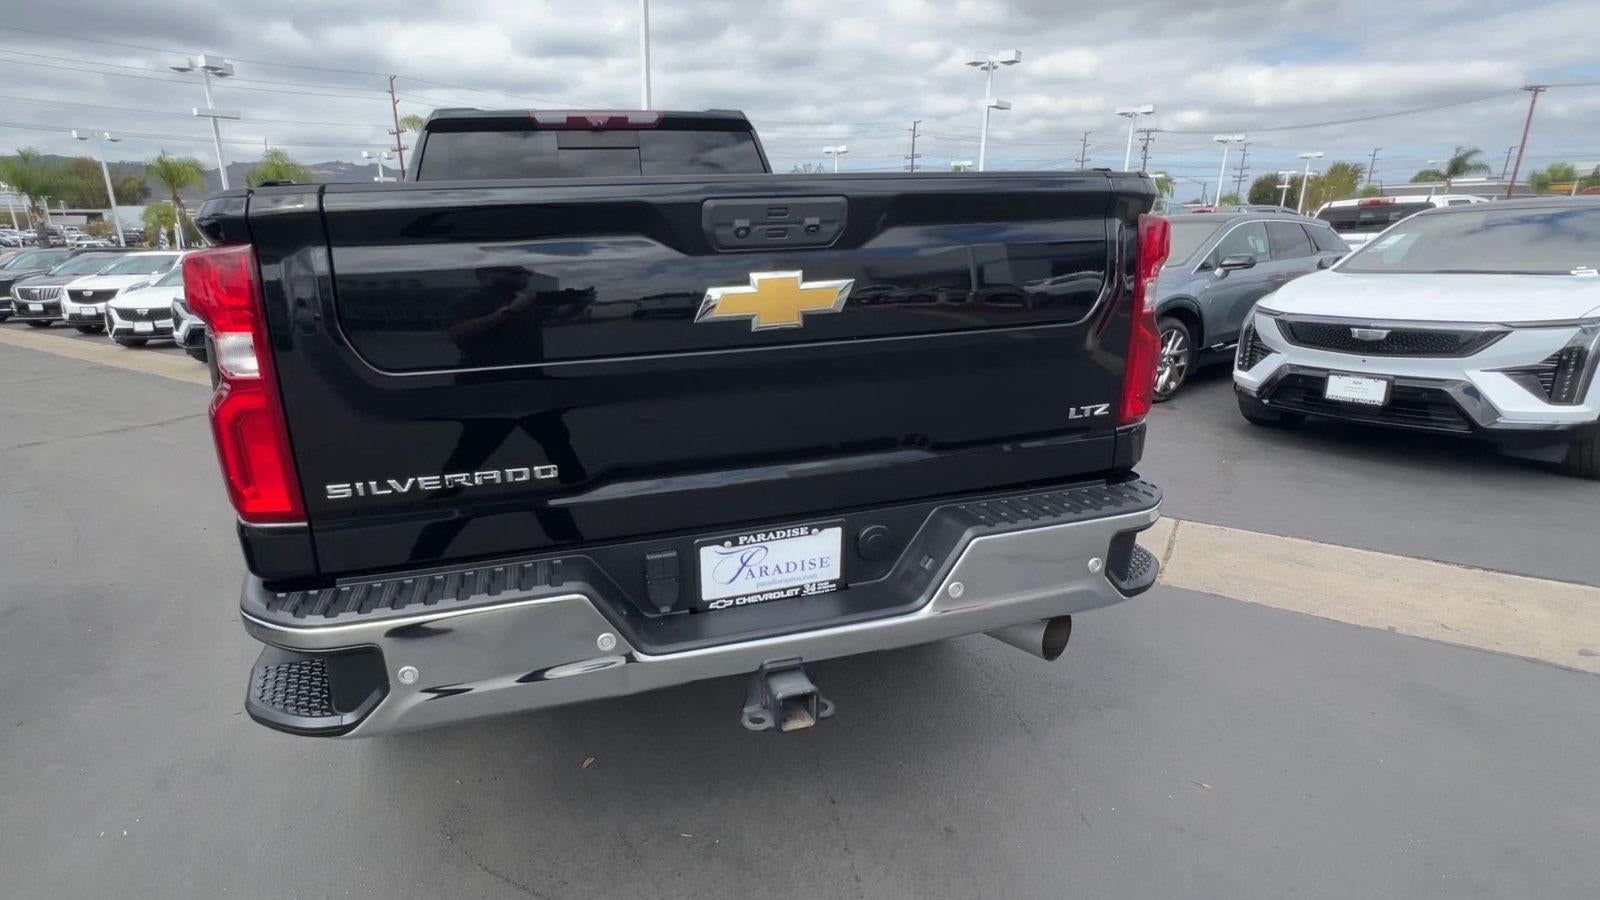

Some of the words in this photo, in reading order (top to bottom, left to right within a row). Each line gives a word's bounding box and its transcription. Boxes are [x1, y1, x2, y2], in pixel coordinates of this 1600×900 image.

[1068, 403, 1110, 419] LTZ
[325, 464, 559, 499] SILVERADO
[738, 526, 809, 545] PARADISE
[713, 545, 831, 585] PARADISE
[735, 587, 801, 606] CHEVROLET
[803, 582, 816, 596] 34
